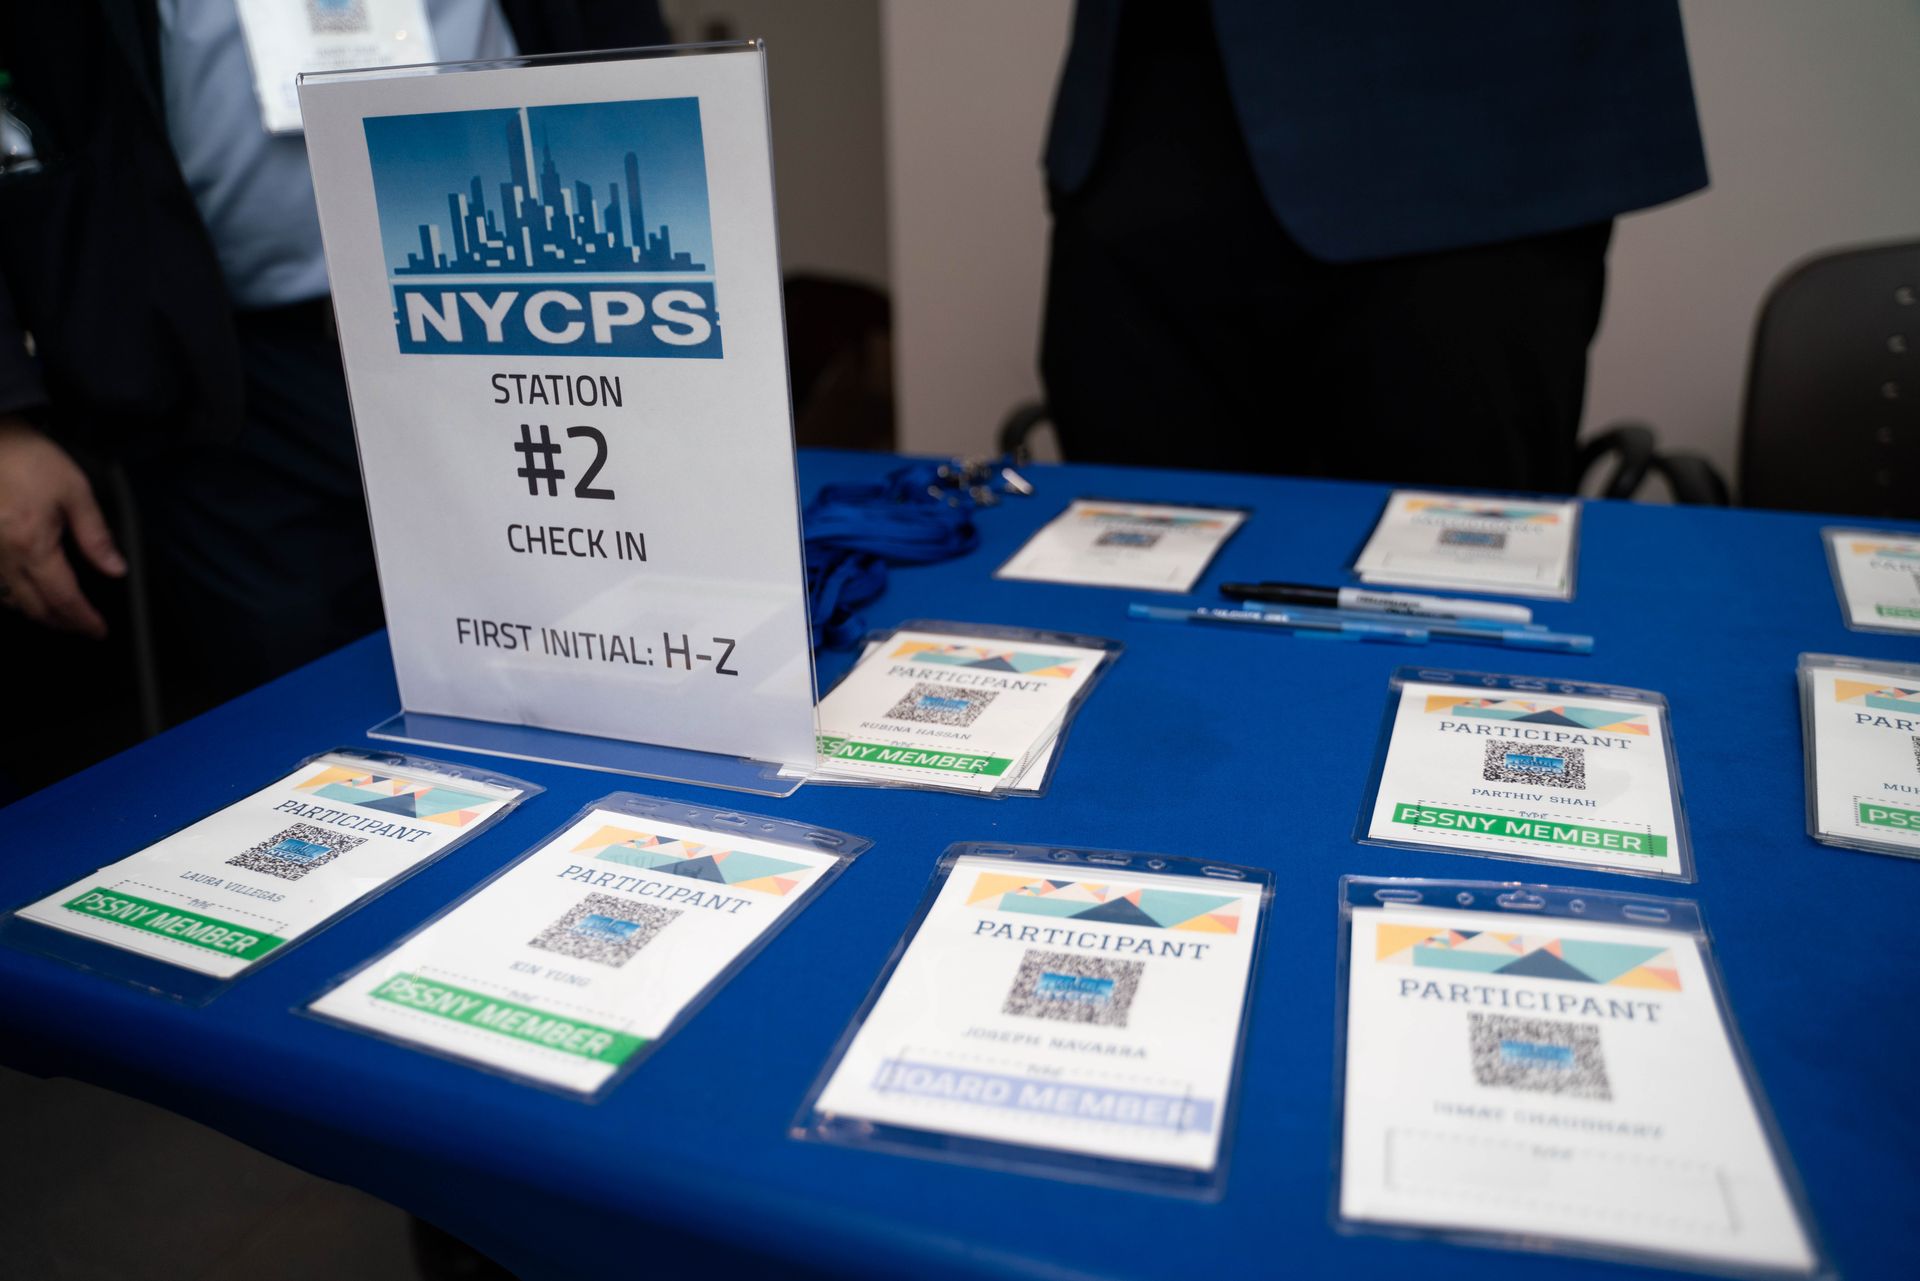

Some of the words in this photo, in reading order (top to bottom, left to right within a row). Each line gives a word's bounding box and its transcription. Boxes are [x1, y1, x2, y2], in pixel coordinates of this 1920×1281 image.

[404, 289, 713, 346] NYCPS
[491, 373, 623, 408] STATION
[514, 423, 616, 501] #2
[506, 523, 608, 560] CHECK
[615, 530, 648, 562] IN
[455, 617, 532, 652] FIRST
[540, 626, 654, 667] INITIAL:
[662, 631, 739, 677] H-Z
[887, 664, 1049, 693] PARTICIPANT
[859, 720, 912, 734] RUBINA
[915, 727, 972, 741] HASSAN
[1438, 720, 1632, 750] PARTICIPANT
[1855, 712, 1920, 732] PAR
[876, 747, 990, 772] MEMBER
[1471, 787, 1544, 802] PARTHIV
[1549, 795, 1597, 808] SHAH
[272, 799, 433, 843] PARTICIPANT
[1400, 807, 1497, 832] PSSNY
[1504, 819, 1643, 851] MEMBER
[179, 870, 222, 888] LAURA
[223, 881, 286, 903] VILLEGAS
[556, 864, 752, 914] PARTICIPANT
[72, 892, 158, 923] PSSNY
[145, 911, 260, 954] MEMBER
[972, 918, 1211, 961] PARTICIPANT
[379, 975, 484, 1017] PSSNY
[472, 1002, 615, 1057] MEMBER
[1397, 978, 1665, 1025] PARTICIPANT
[1016, 1079, 1198, 1129] MEMBER
